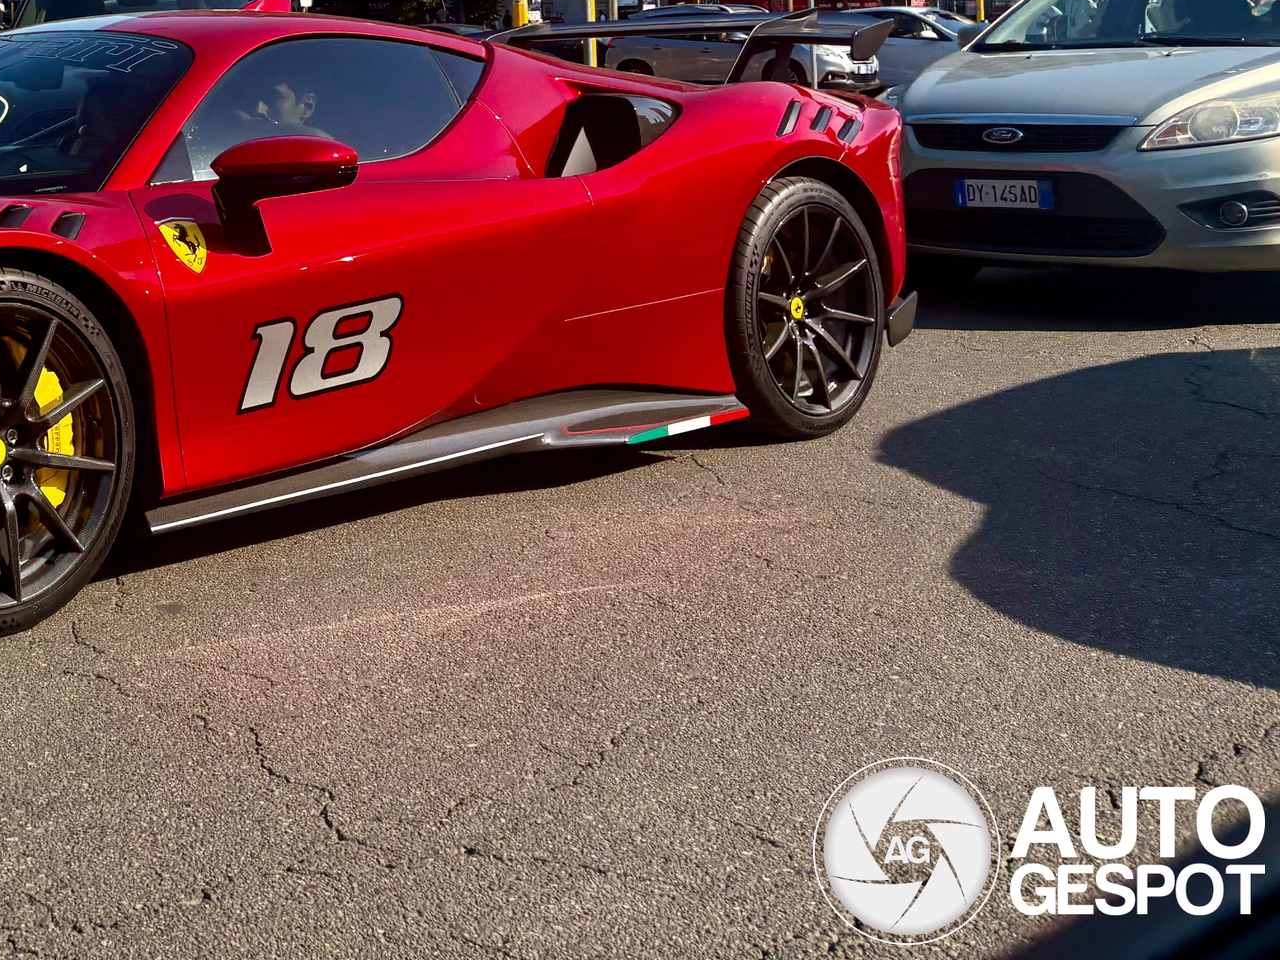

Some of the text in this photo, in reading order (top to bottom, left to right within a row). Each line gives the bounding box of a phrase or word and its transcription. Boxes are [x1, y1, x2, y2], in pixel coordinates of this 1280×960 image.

[991, 130, 1012, 140] Ford
[26, 283, 80, 319] MICHELIN
[746, 273, 754, 335] MICHELIN
[236, 292, 405, 415] 18
